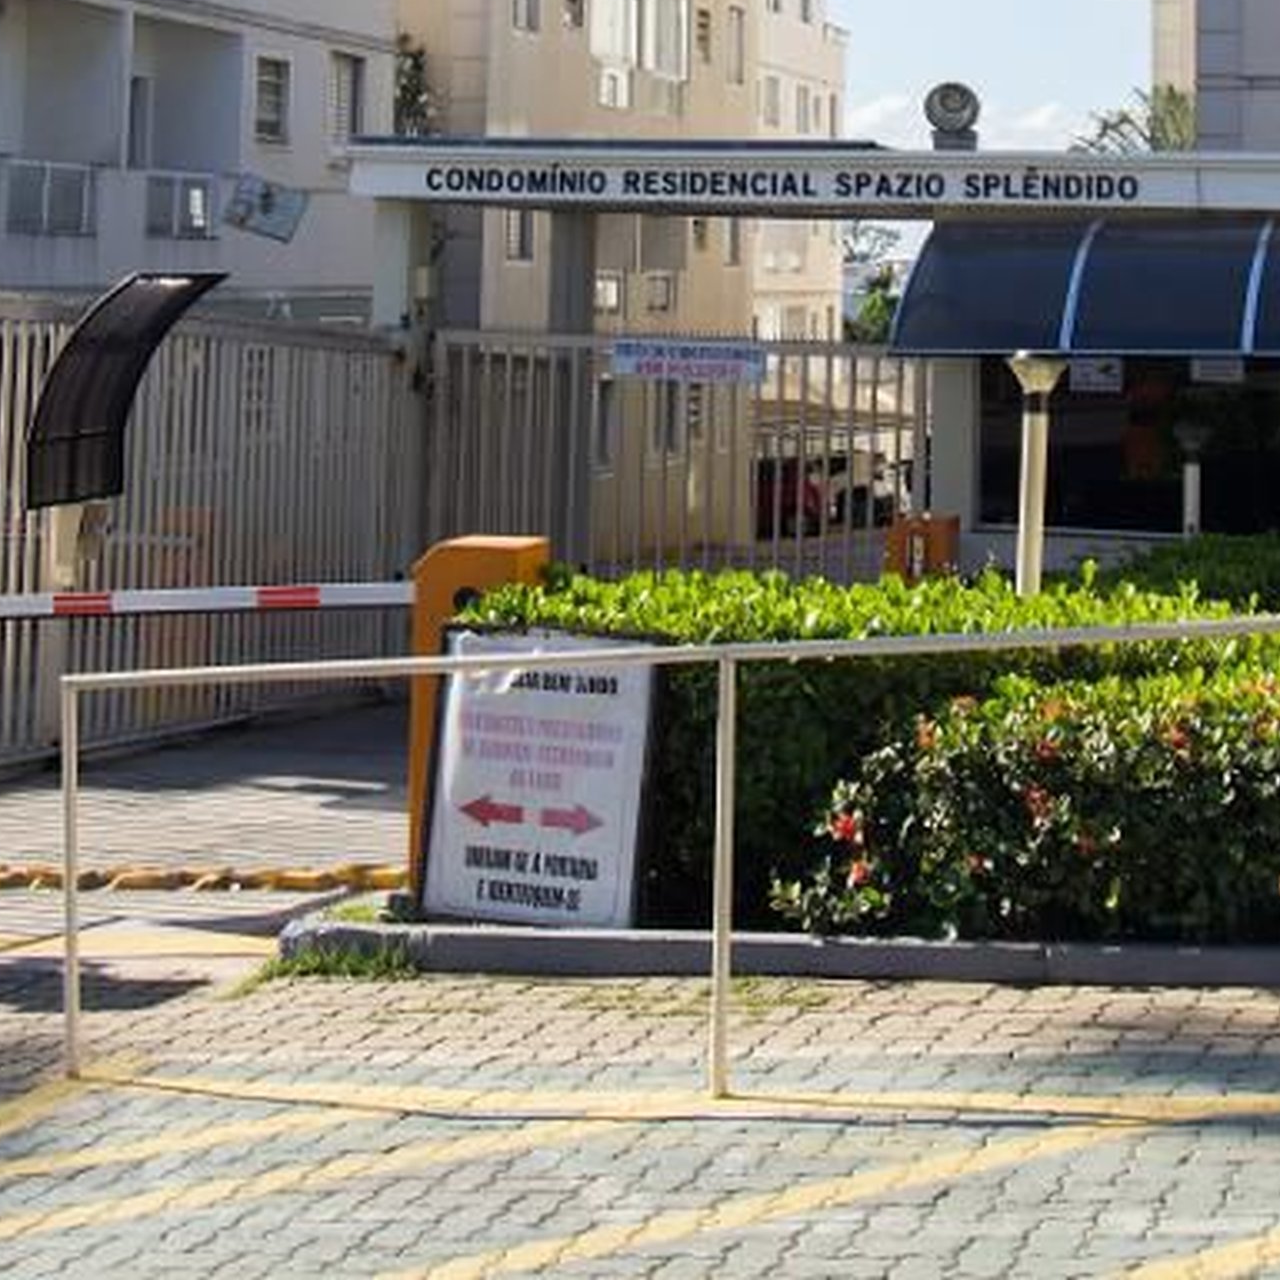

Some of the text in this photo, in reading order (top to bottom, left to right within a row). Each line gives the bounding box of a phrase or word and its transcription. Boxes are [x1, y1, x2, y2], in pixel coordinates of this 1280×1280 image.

[426, 163, 1139, 199] CONDOMÍNIO RESIDENCIAL SPAZIO SPLÊNDIDO
